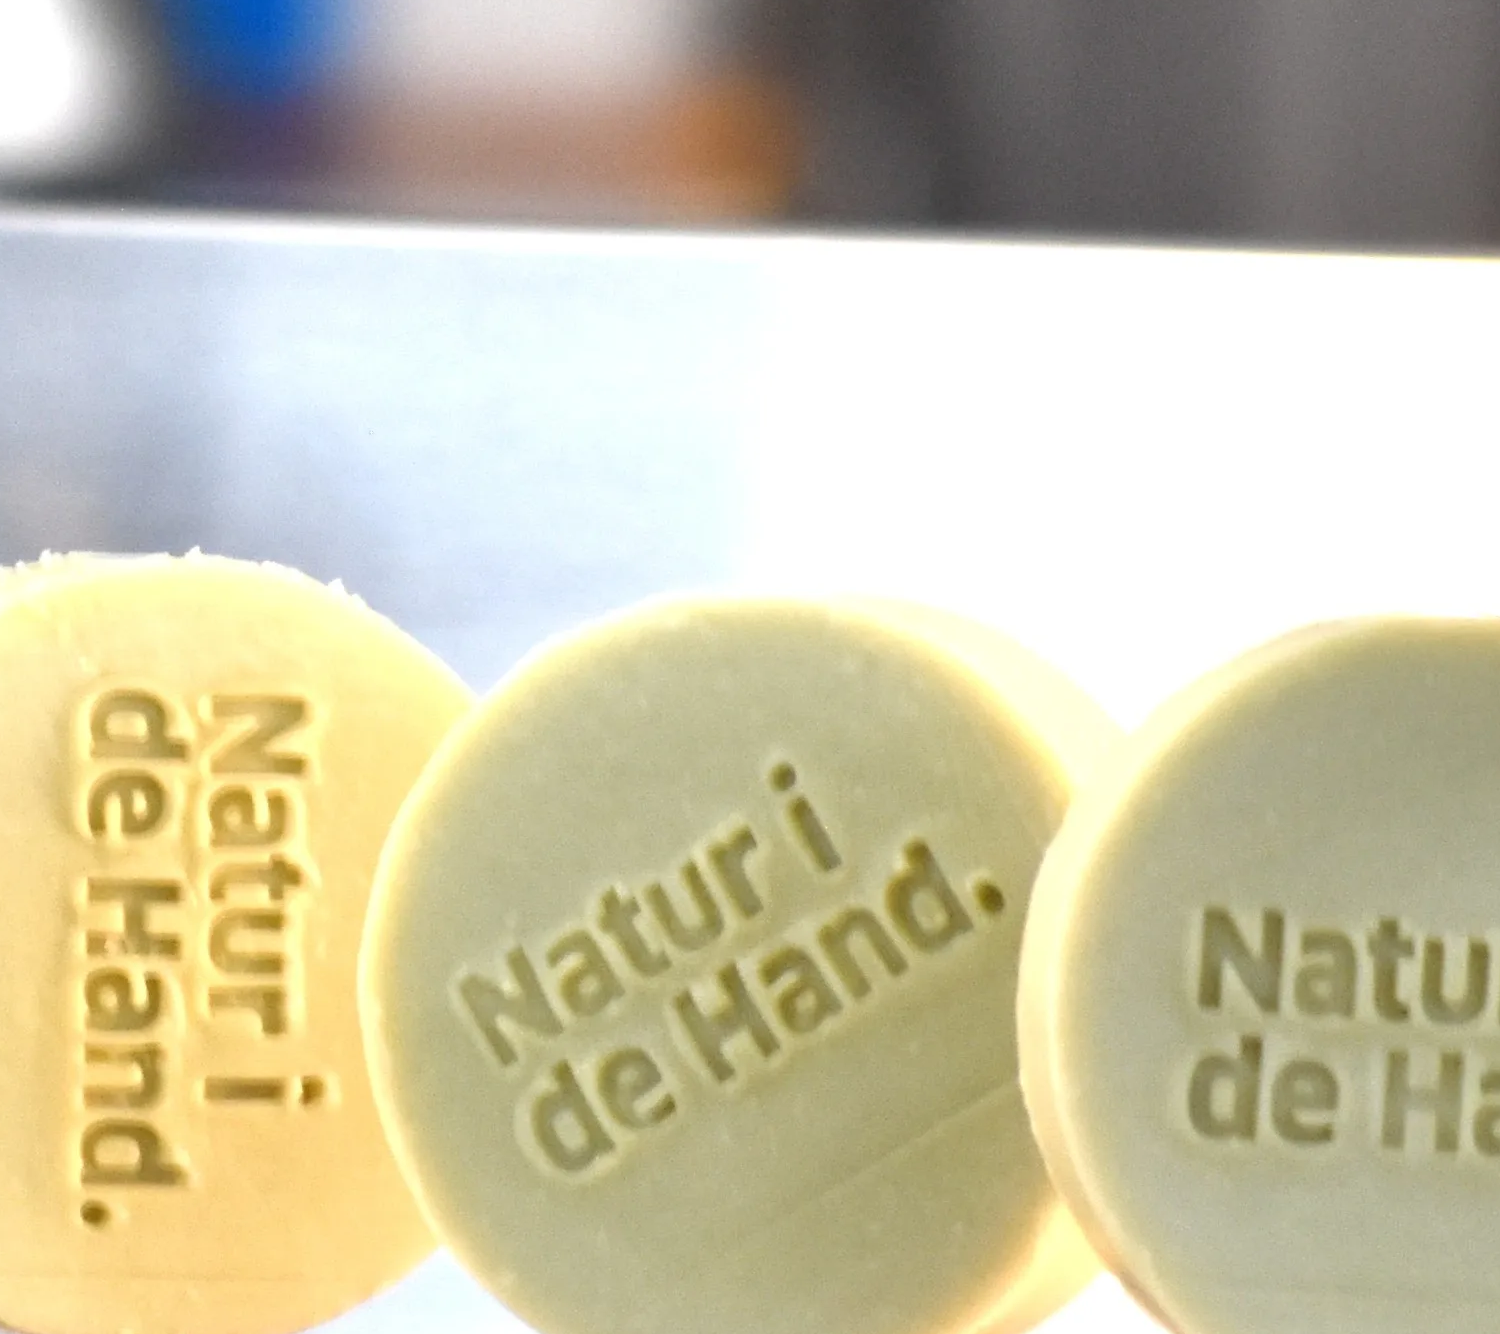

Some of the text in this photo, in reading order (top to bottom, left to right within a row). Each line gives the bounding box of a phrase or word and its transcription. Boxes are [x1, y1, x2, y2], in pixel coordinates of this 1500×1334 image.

[79, 687, 189, 1228] de Hand.
[203, 693, 326, 1108] Natur i
[458, 762, 842, 1067] Natur i
[531, 836, 1005, 1172] de Hand.
[1187, 1035, 1340, 1146] de
